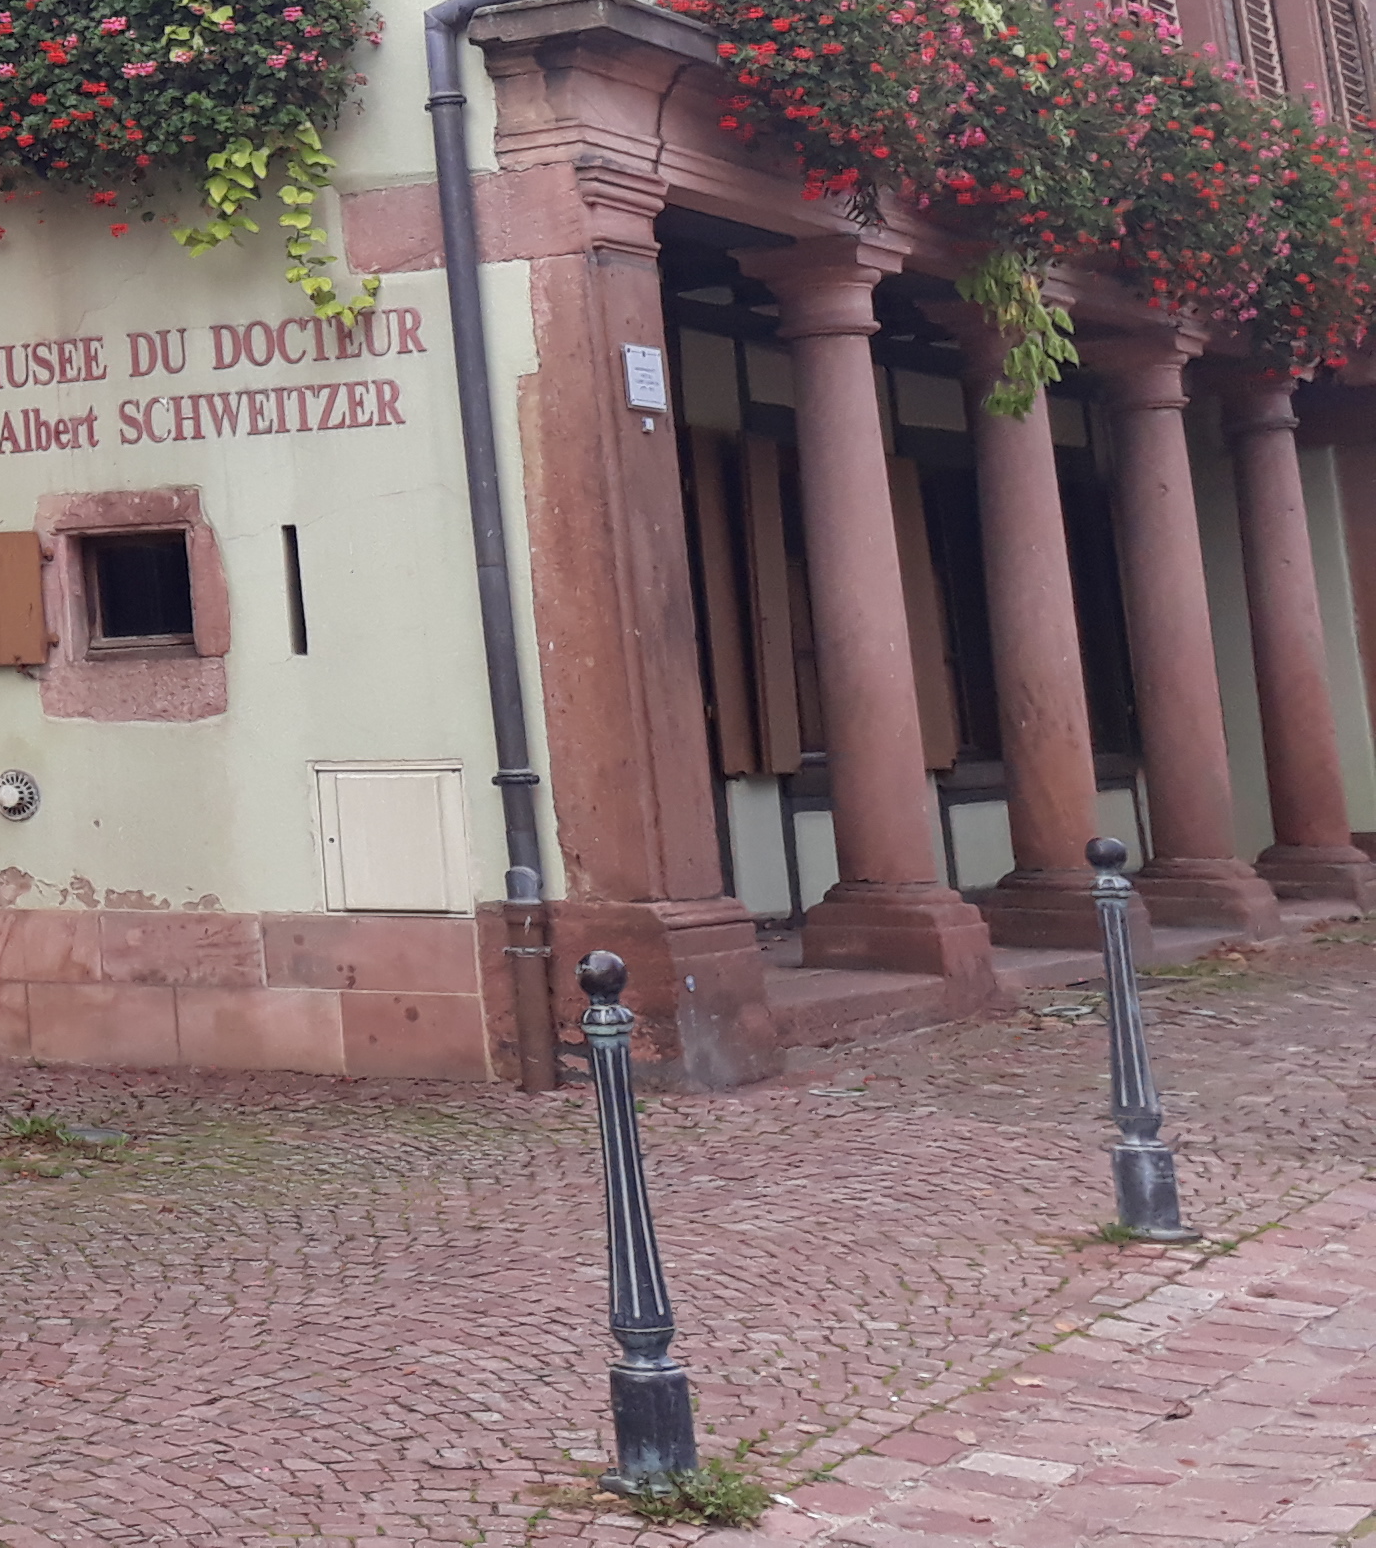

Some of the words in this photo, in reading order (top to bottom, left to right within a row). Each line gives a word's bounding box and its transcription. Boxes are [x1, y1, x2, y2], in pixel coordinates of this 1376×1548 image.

[127, 328, 187, 378] DU
[211, 306, 428, 371] DOCTEUR
[119, 379, 407, 446] SCHWEITZER
